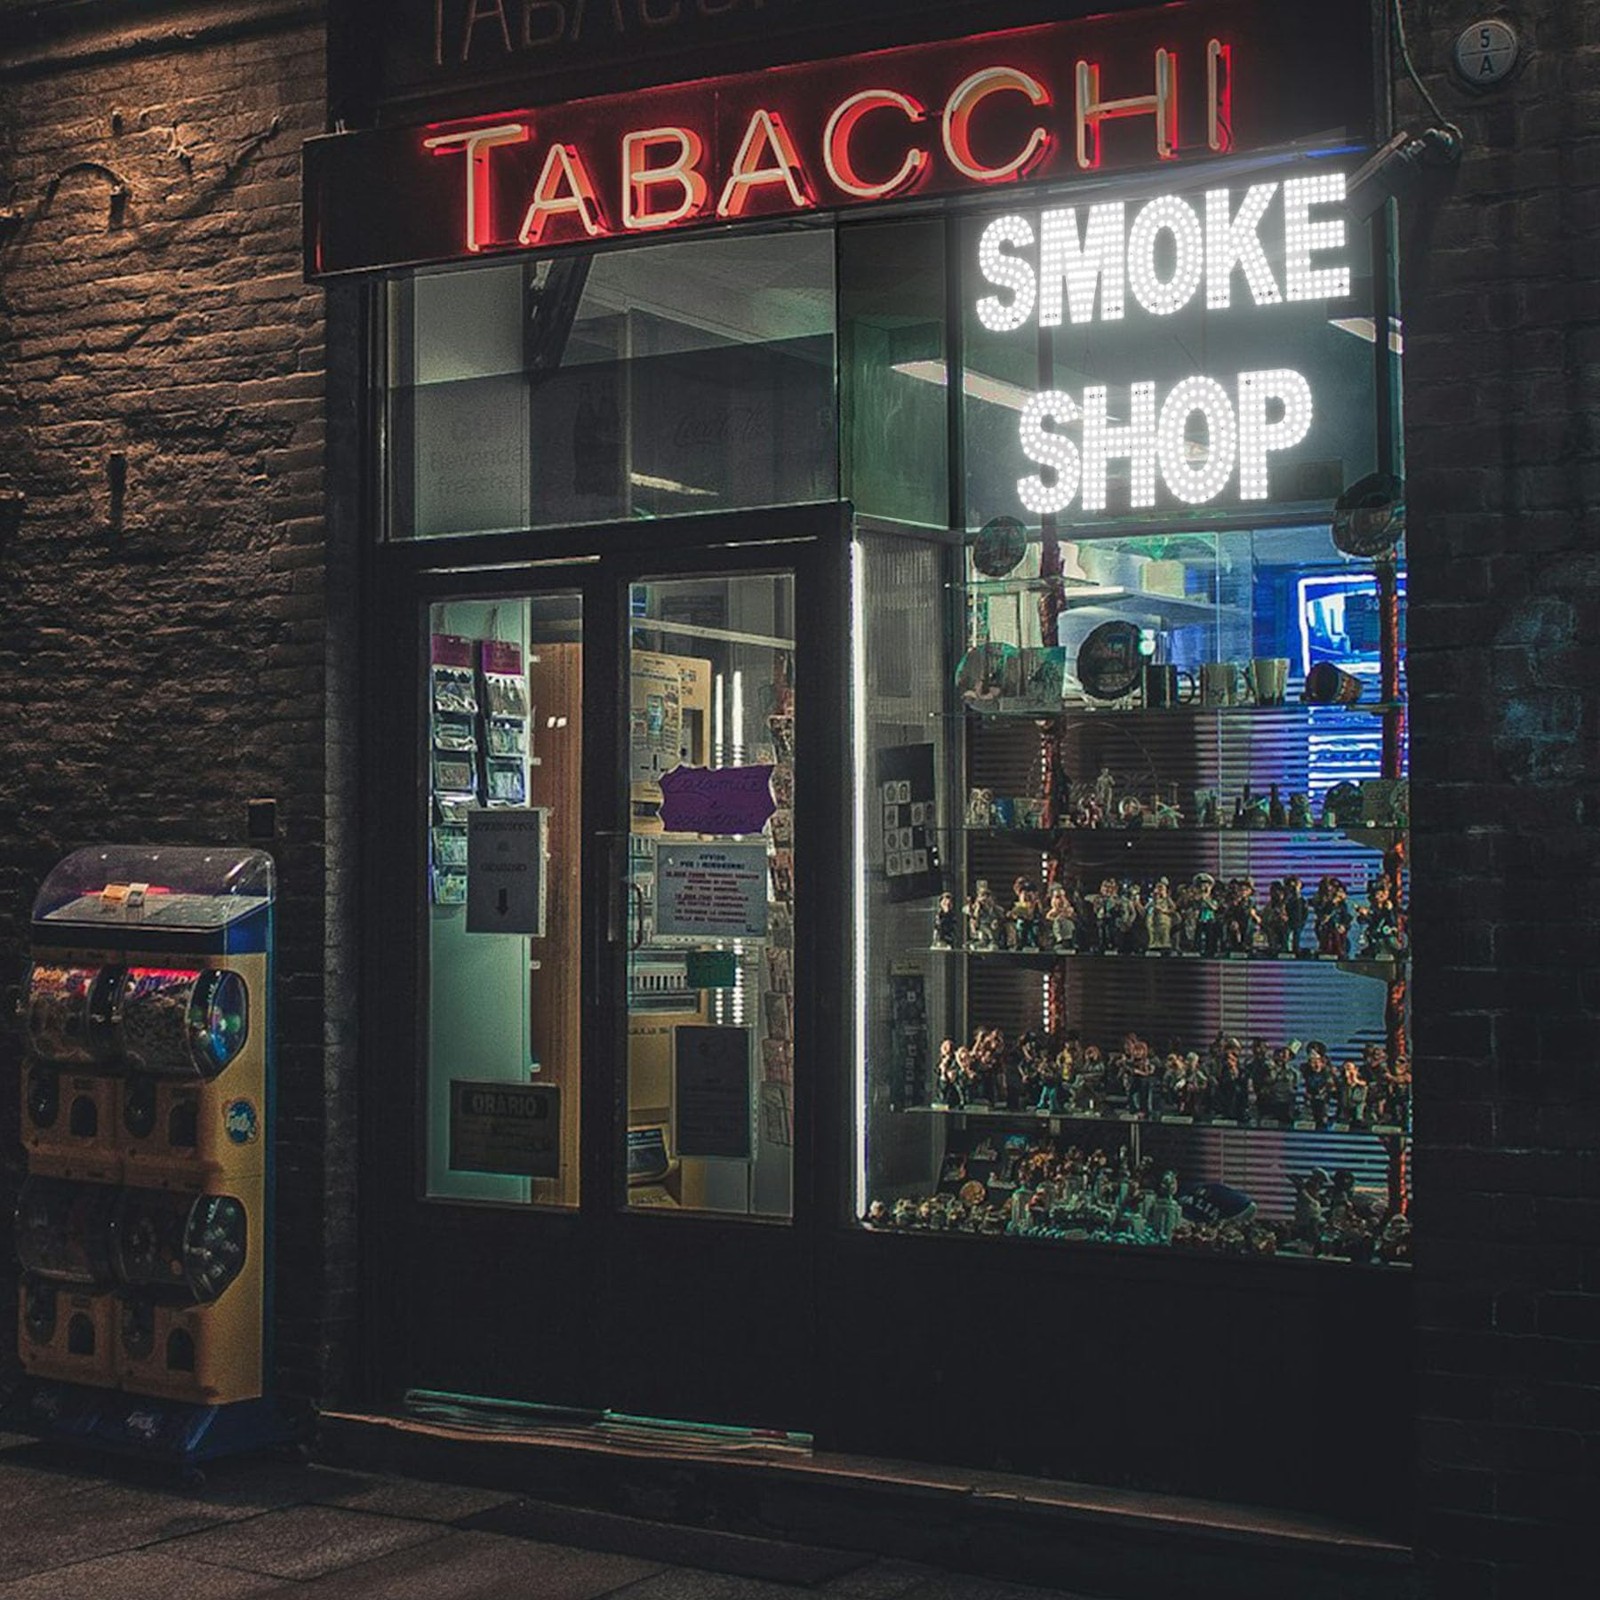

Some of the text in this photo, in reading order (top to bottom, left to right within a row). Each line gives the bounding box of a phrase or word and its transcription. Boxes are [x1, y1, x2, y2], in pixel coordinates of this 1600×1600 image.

[1479, 55, 1494, 75] A
[1480, 28, 1490, 48] 5
[423, 37, 1231, 253] TABACCHI
[976, 172, 1350, 332] SMOKE
[1016, 367, 1313, 514] SHOP
[472, 1092, 538, 1118] ORARIO
